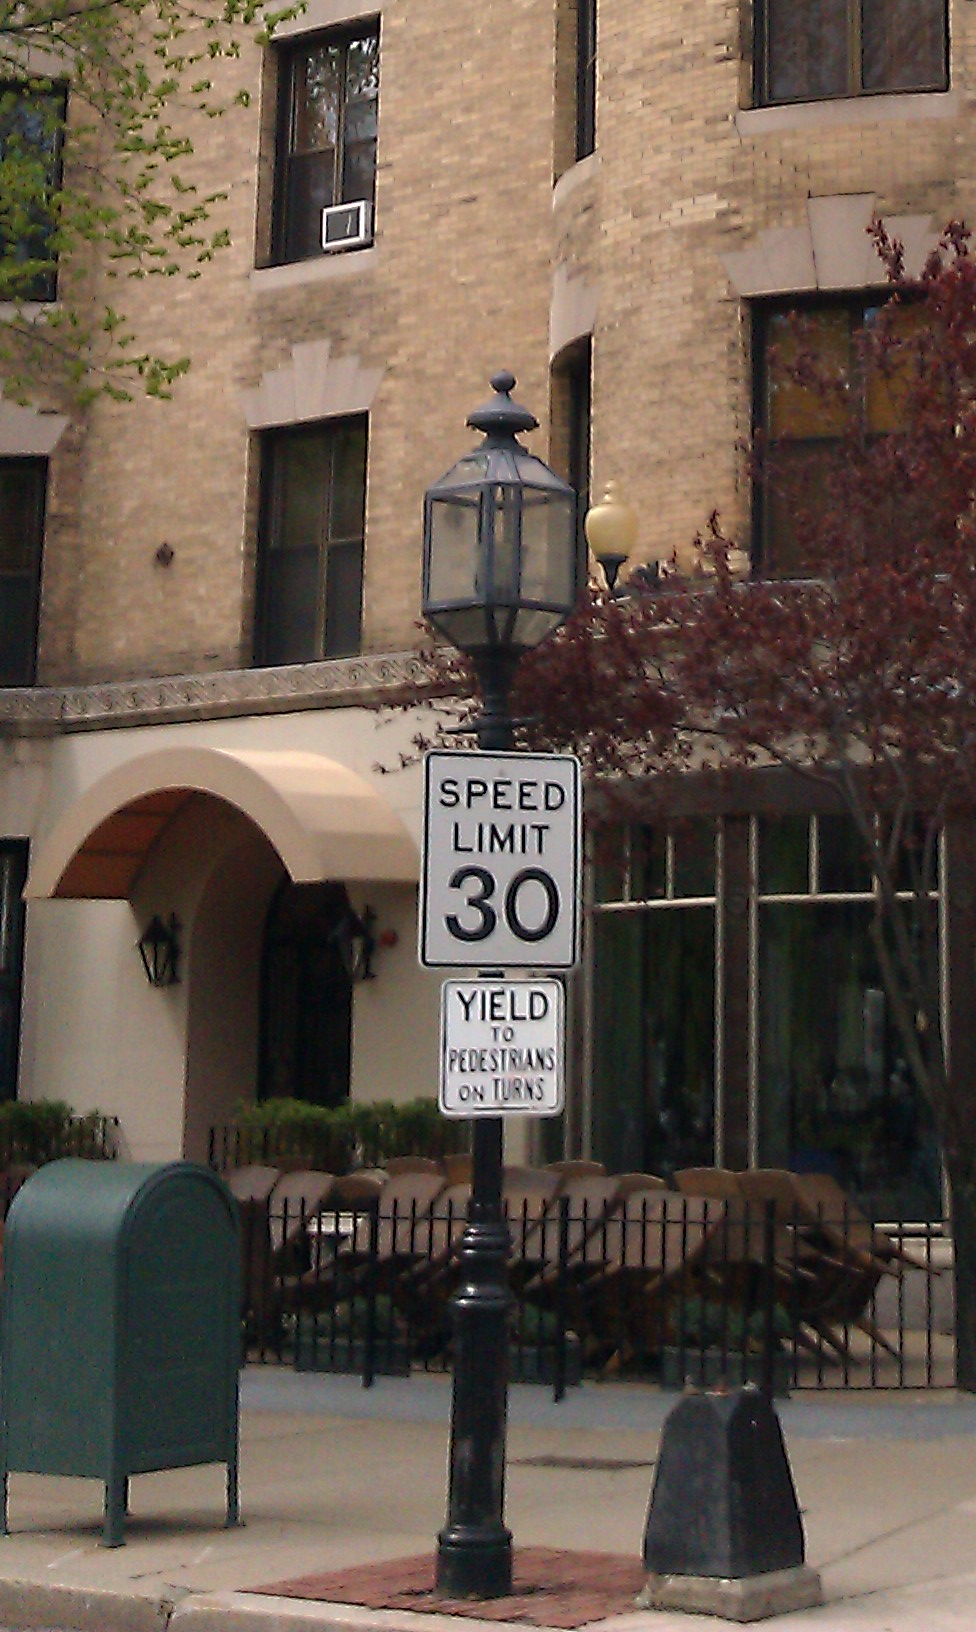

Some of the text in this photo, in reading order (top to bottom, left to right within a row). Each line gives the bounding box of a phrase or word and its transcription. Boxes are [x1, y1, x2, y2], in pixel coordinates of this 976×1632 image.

[440, 778, 566, 811] SPEED
[453, 822, 550, 855] LIMIT
[444, 865, 560, 943] 30
[456, 989, 549, 1021] YIELD
[491, 1026, 515, 1042] TO
[449, 1048, 555, 1072] PEDESTRIANS
[458, 1077, 545, 1101] ON TURNS
